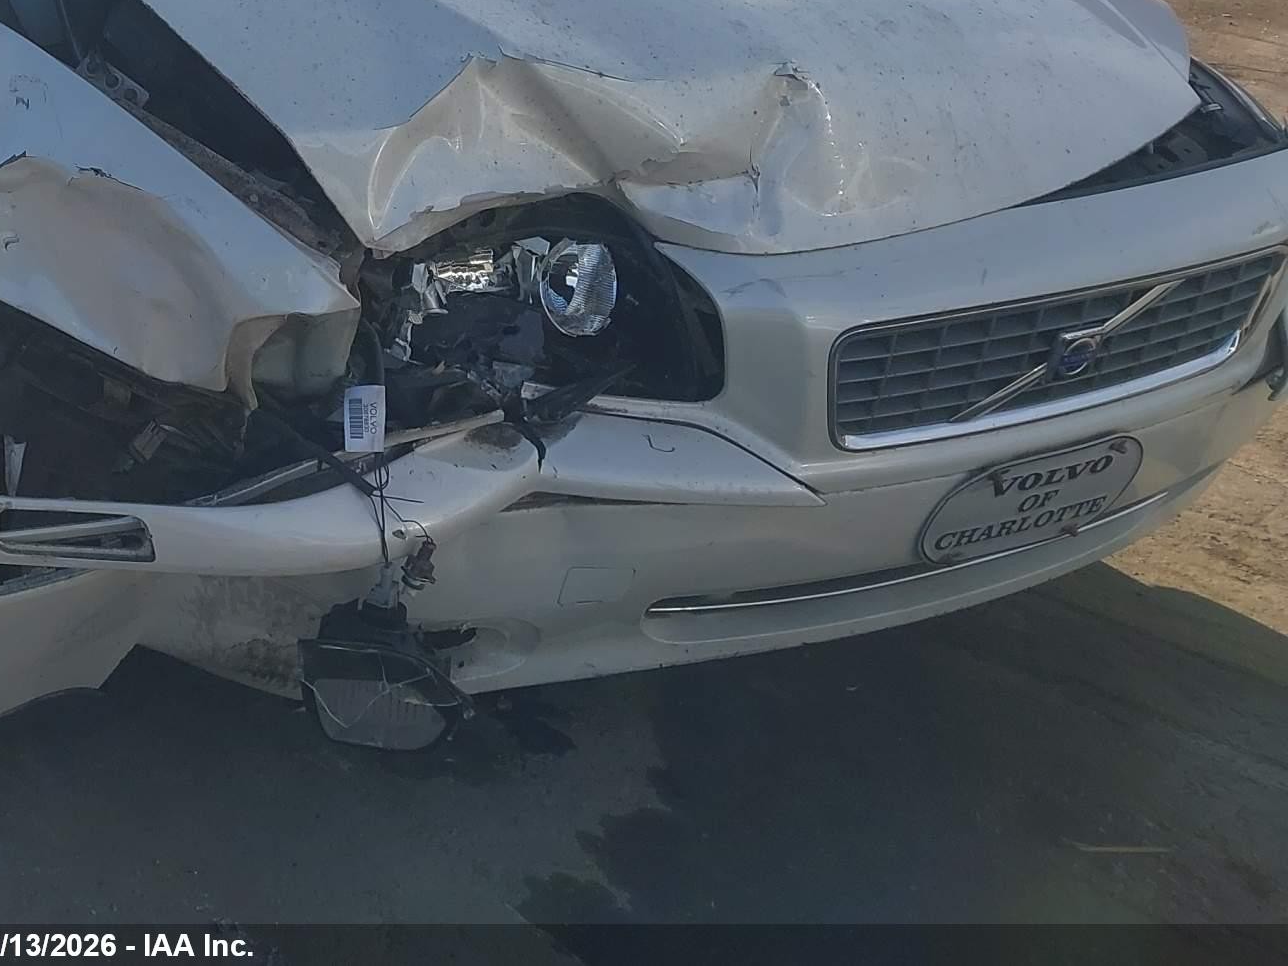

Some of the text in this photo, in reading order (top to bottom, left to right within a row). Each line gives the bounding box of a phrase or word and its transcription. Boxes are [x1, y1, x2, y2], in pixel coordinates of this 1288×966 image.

[369, 401, 378, 434] VOLVO
[987, 454, 1114, 498] VOLVO
[1018, 489, 1060, 513] OF
[934, 494, 1108, 551] CHARLOTTE
